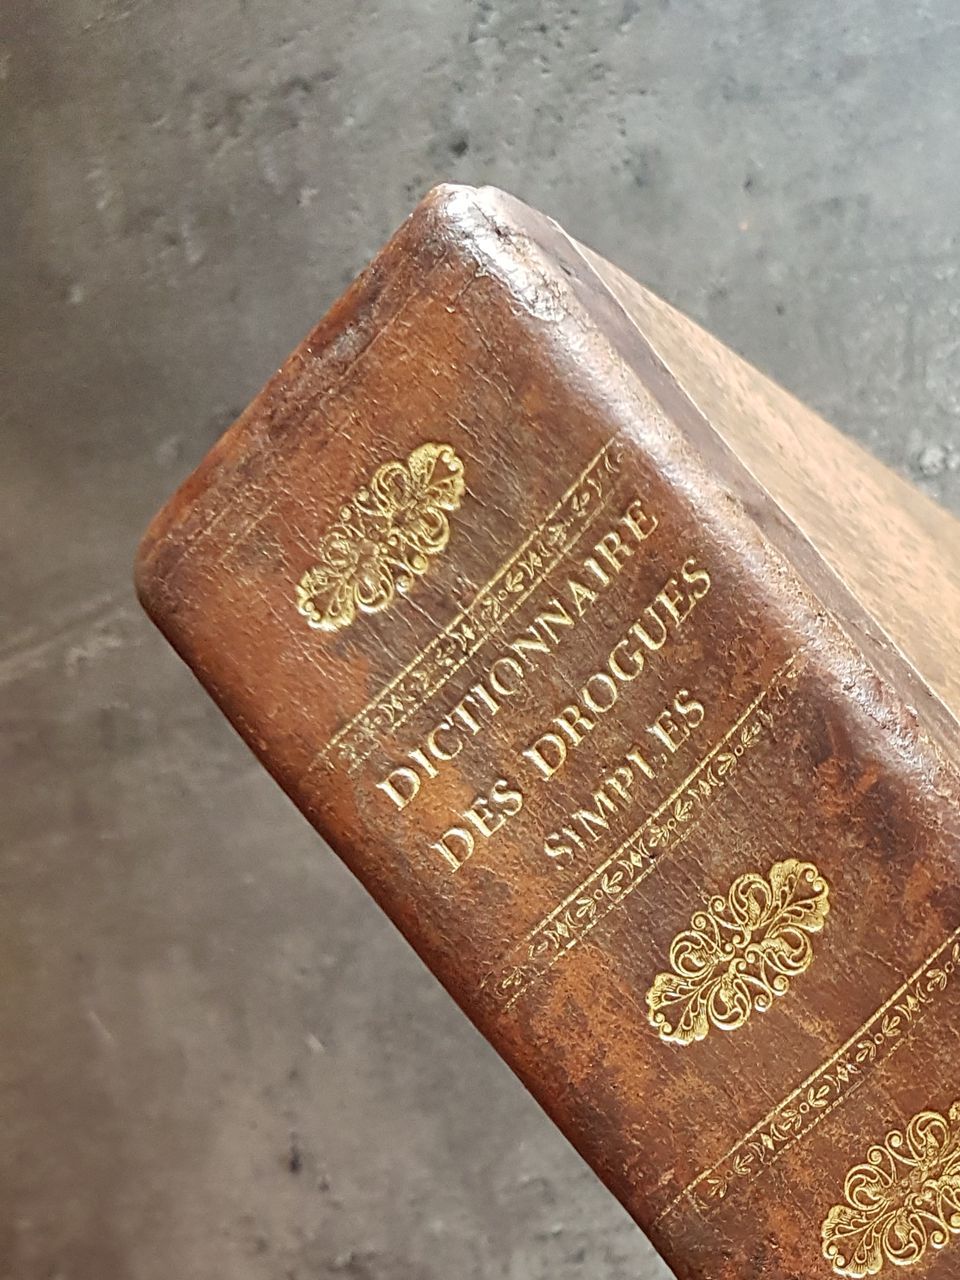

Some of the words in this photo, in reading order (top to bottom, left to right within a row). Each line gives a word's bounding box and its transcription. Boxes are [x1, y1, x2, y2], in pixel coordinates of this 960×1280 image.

[376, 499, 659, 812] DICTIONNAIRE
[429, 778, 523, 874] DES
[522, 558, 712, 781] DROGUES
[543, 689, 706, 870] SIMPLES
